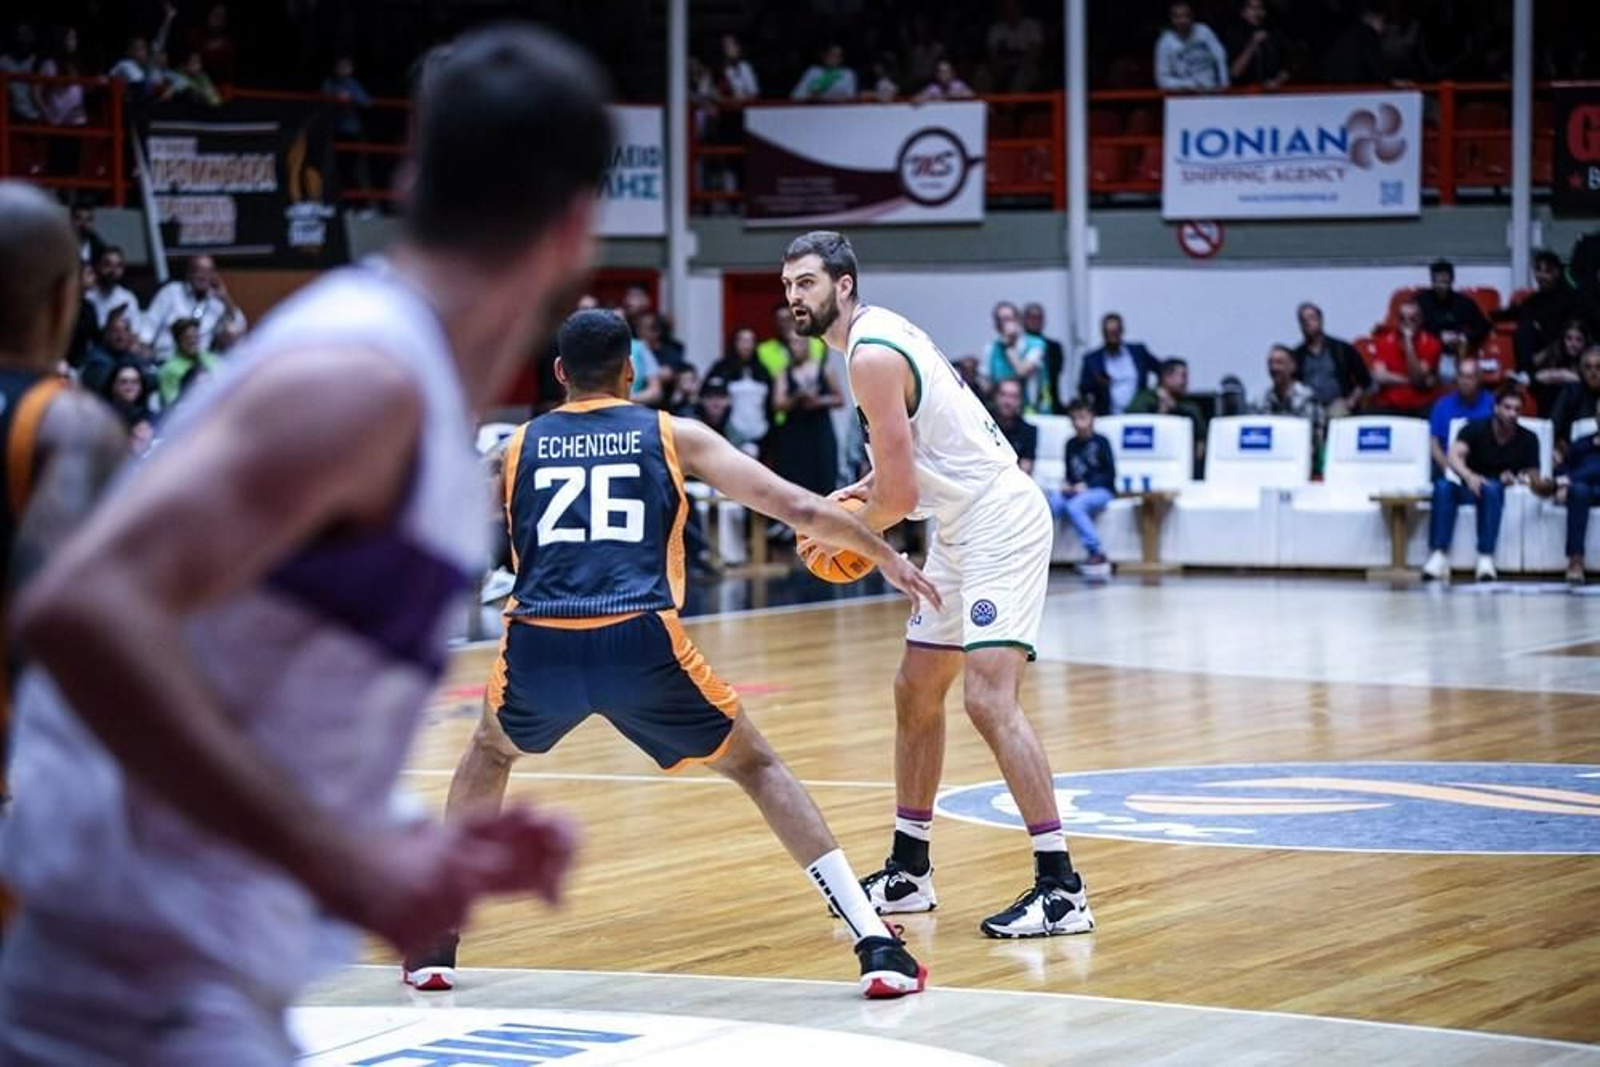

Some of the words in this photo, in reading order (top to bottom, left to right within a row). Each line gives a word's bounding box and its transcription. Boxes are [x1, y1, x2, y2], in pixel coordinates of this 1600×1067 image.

[1180, 126, 1349, 158] IONIAN
[1273, 165, 1345, 182] AGENCY
[537, 431, 642, 459] ECHENIQUE
[534, 463, 646, 547] 26
